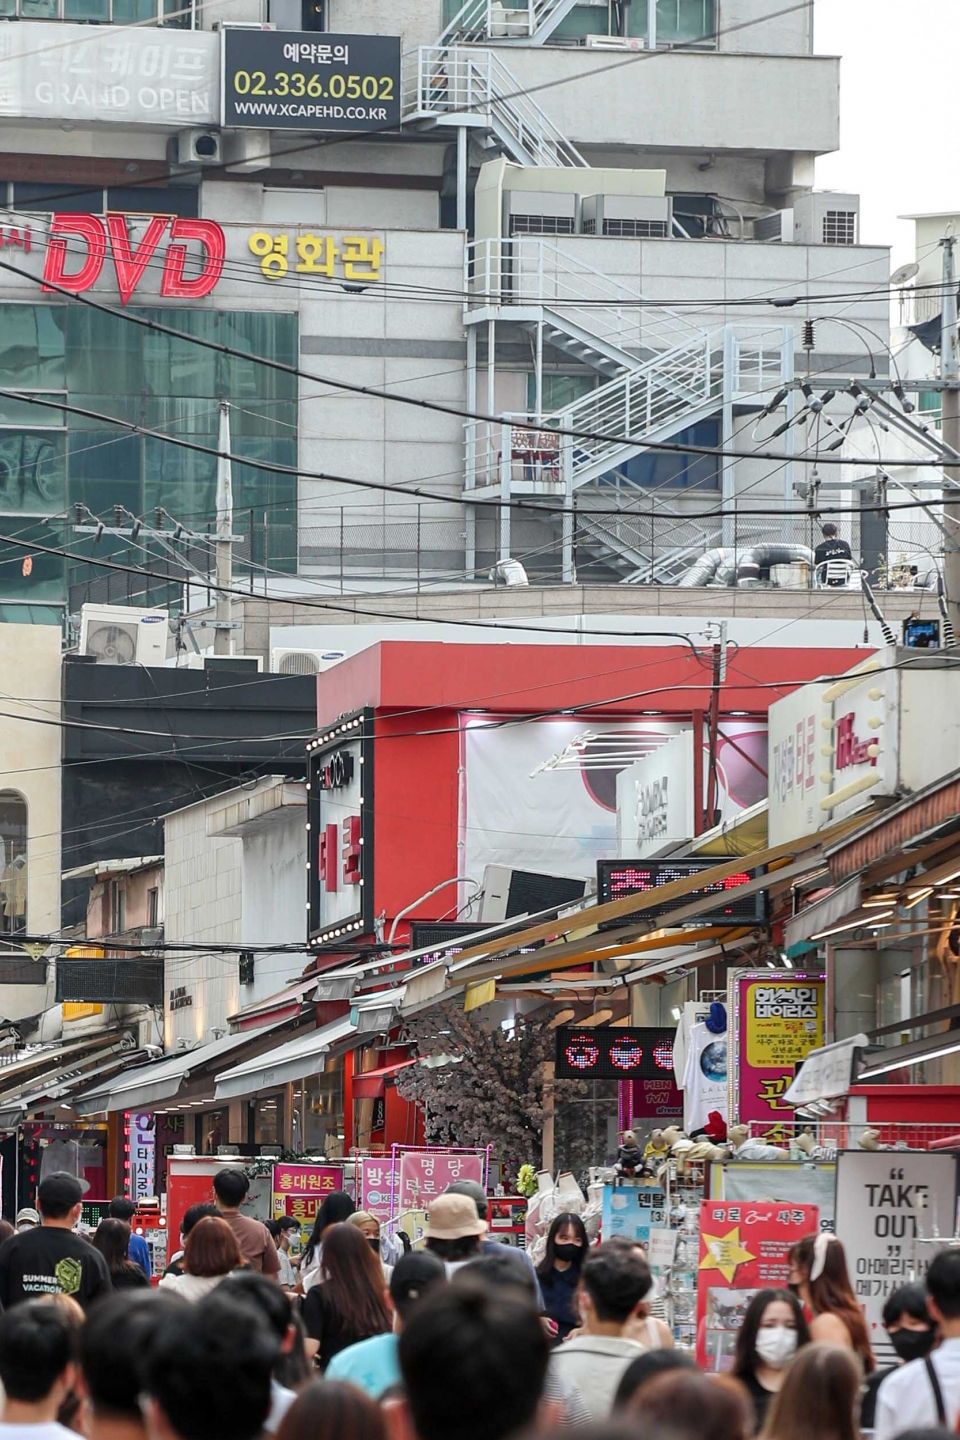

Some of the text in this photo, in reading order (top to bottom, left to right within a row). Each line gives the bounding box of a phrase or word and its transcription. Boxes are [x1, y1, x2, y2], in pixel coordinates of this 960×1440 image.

[283, 43, 349, 65] 예약문의
[234, 71, 394, 101] 02.336.0502
[35, 82, 210, 113] GRAND OPEN
[234, 102, 388, 120] WWW.XCAPEHD.CO.KR
[43, 211, 227, 308] DVD
[248, 231, 386, 281] 영화관
[279, 1173, 335, 1190] 홍대원조
[22, 1274, 58, 1284] SUMMER
[22, 1284, 63, 1293] VACATION
